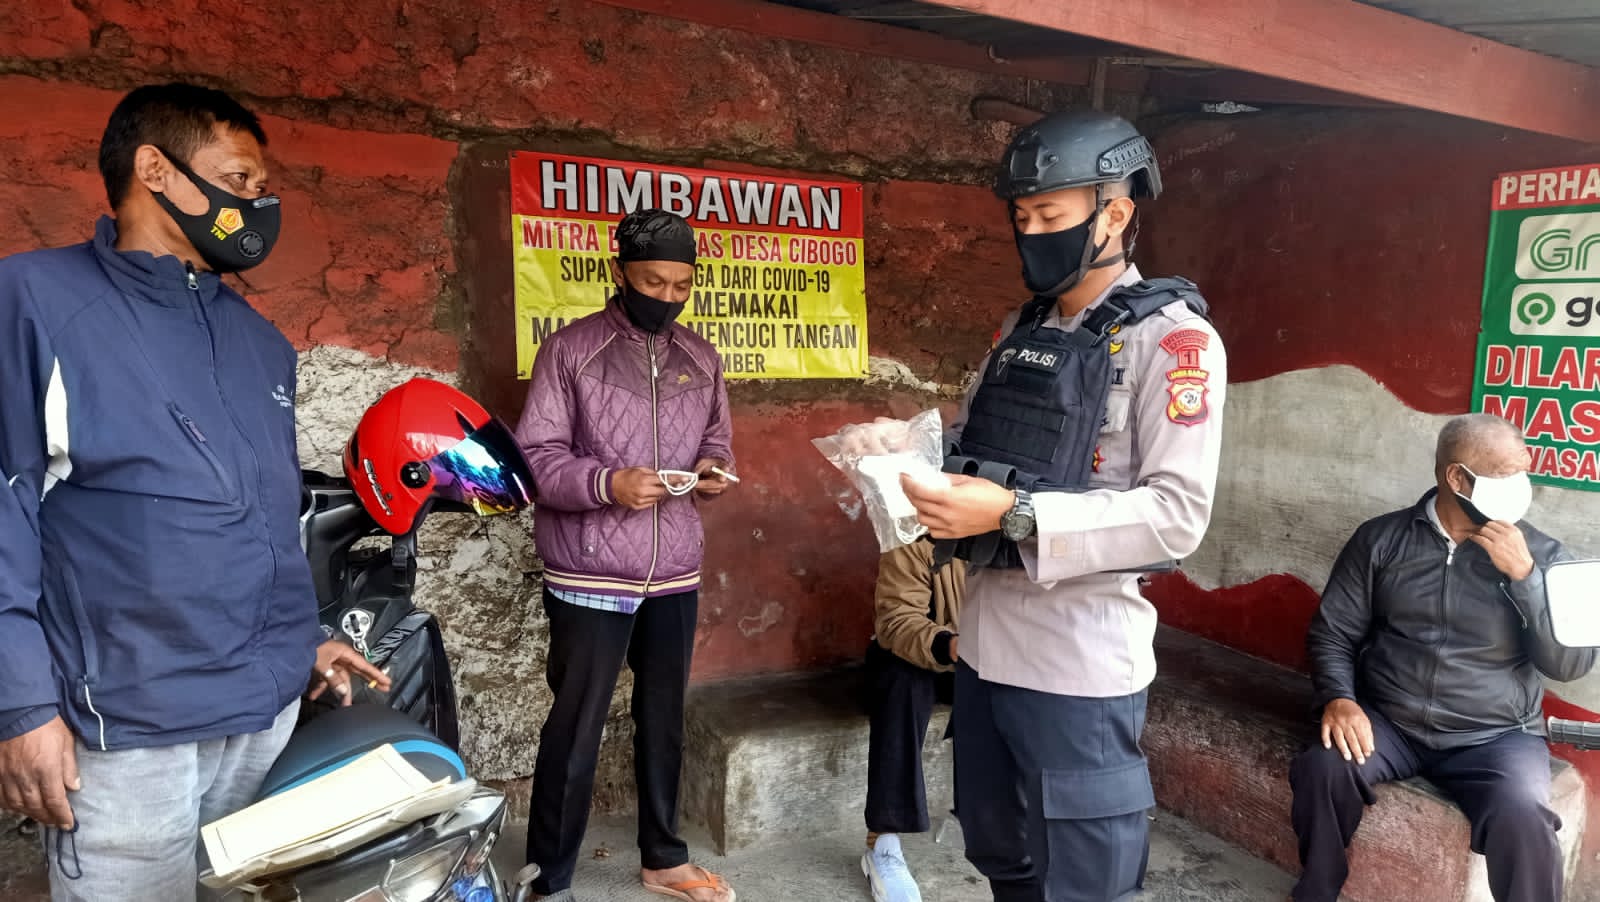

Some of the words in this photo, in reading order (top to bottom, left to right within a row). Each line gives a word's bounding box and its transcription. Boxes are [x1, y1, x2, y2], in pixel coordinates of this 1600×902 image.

[540, 160, 841, 231] HIMBAWAN
[522, 219, 600, 252] MITRA
[730, 233, 782, 263] DESA
[788, 236, 858, 266] CIBOGO
[721, 264, 757, 289] DARI
[762, 267, 831, 293] COVID-19
[693, 290, 799, 320] MEMAKAI
[782, 324, 858, 350] TANGAN
[1017, 348, 1058, 368] POLISI
